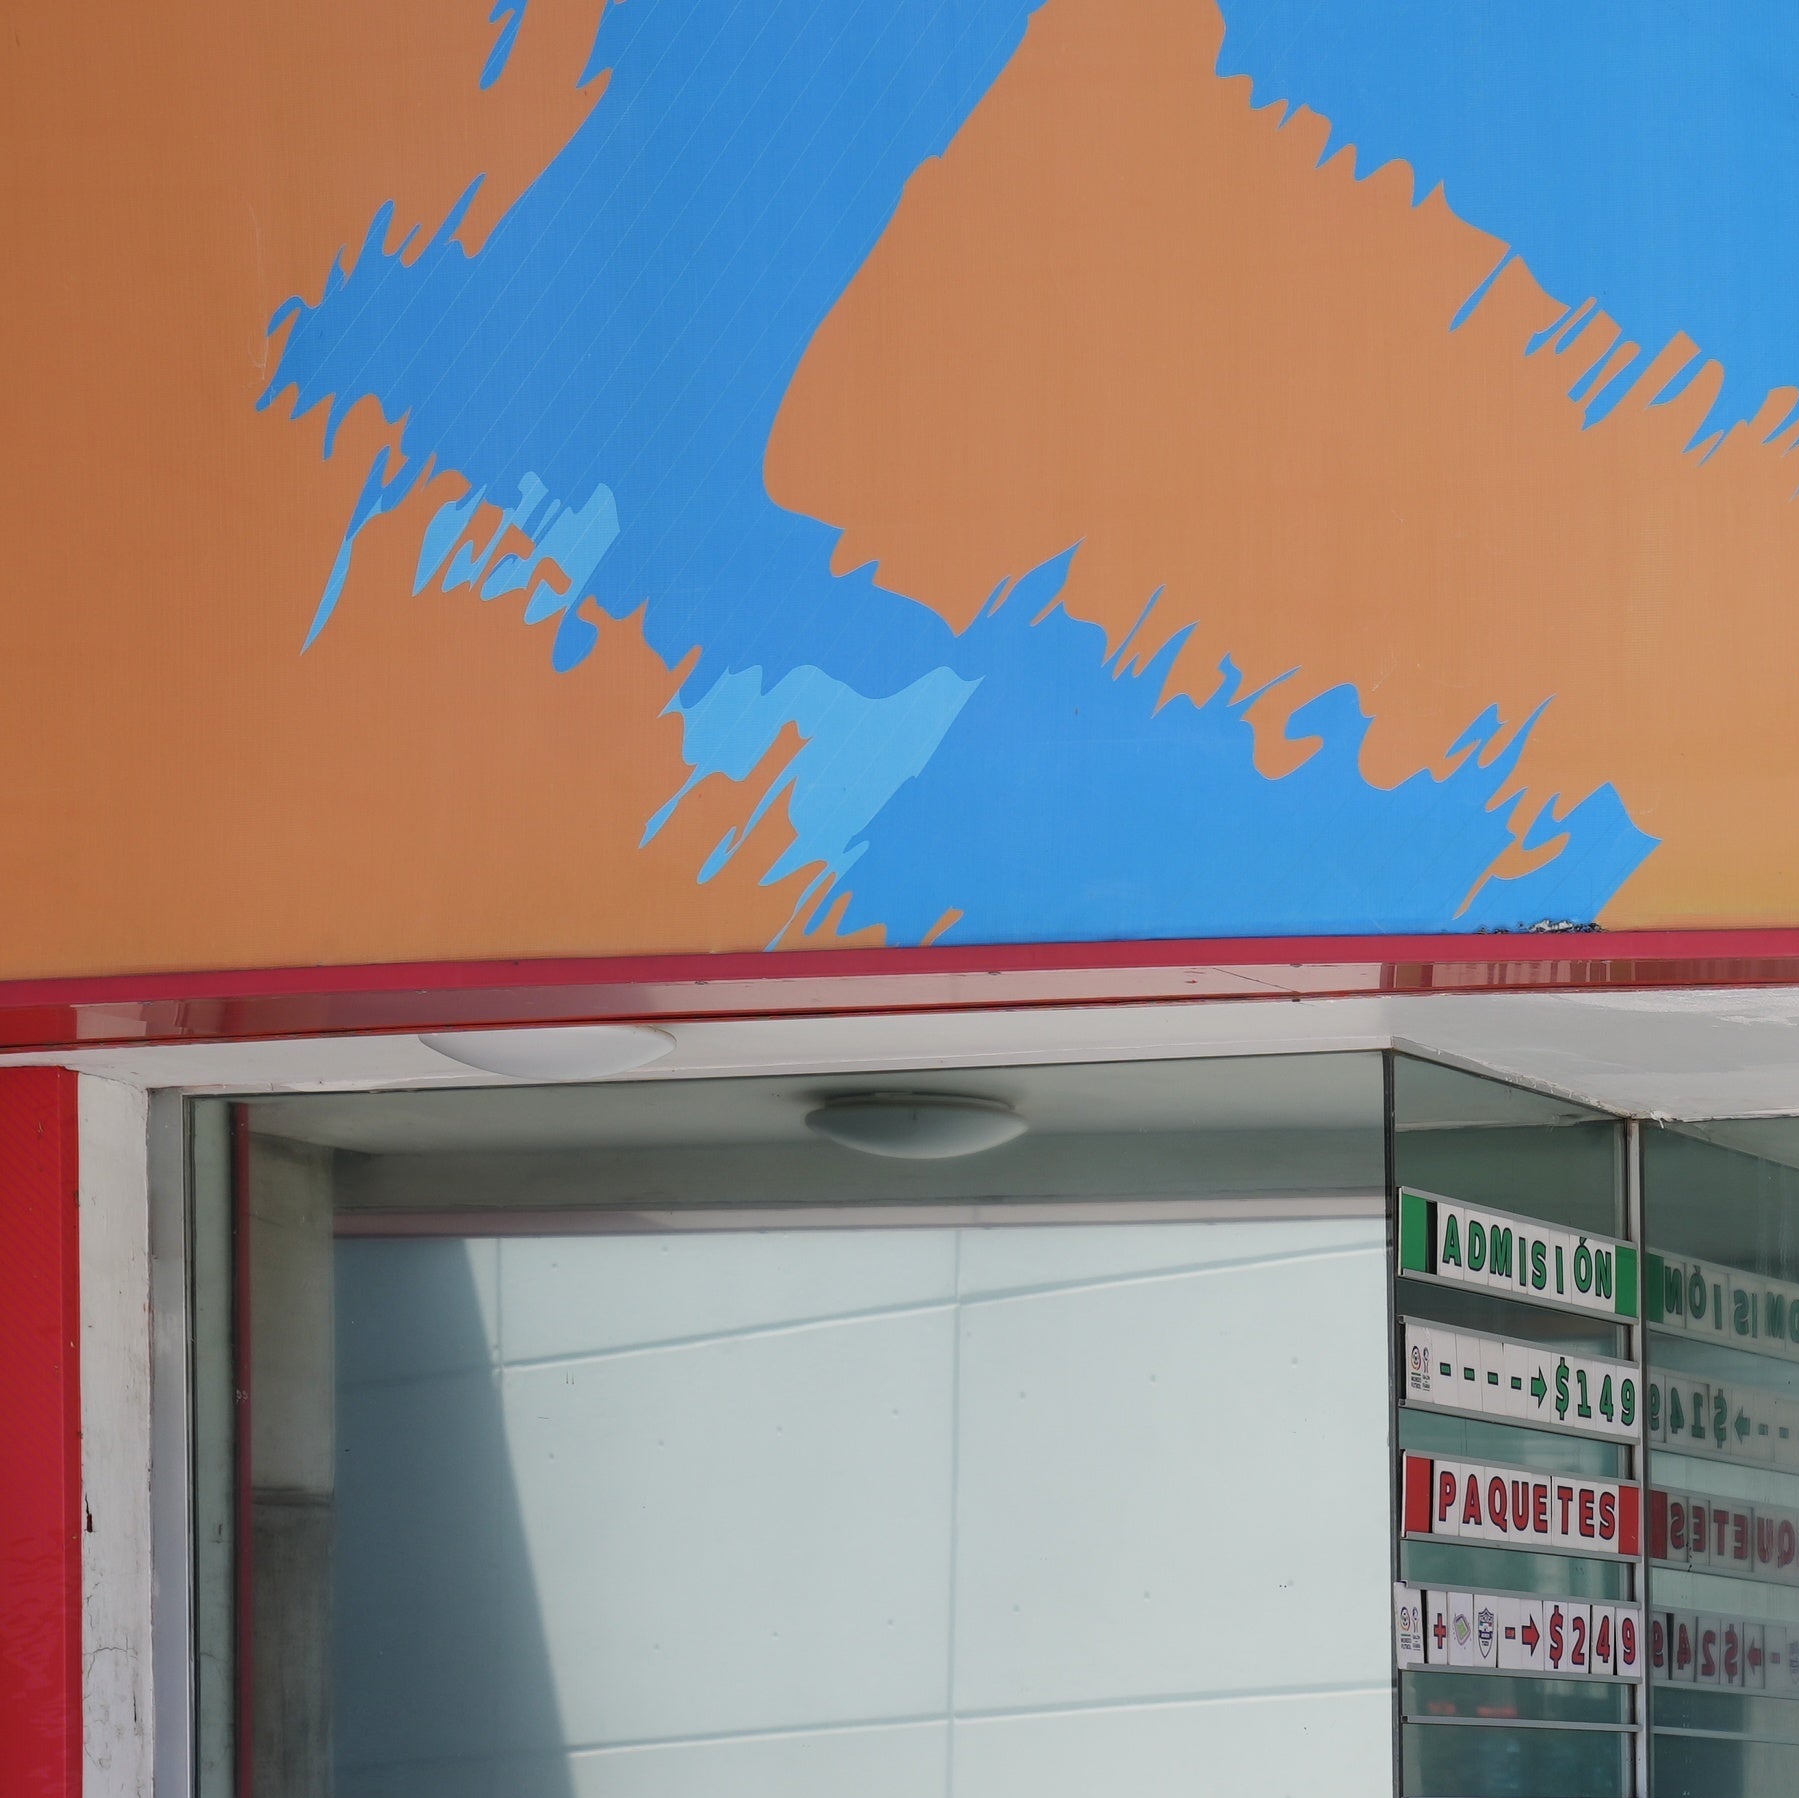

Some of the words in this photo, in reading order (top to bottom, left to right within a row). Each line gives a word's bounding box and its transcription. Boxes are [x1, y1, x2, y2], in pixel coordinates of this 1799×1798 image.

[1442, 1213, 1612, 1300] ADMISIÓN
[1555, 1356, 1636, 1426] $149
[1438, 1471, 1617, 1541] PAQUETES
[1548, 1606, 1636, 1669] $249
